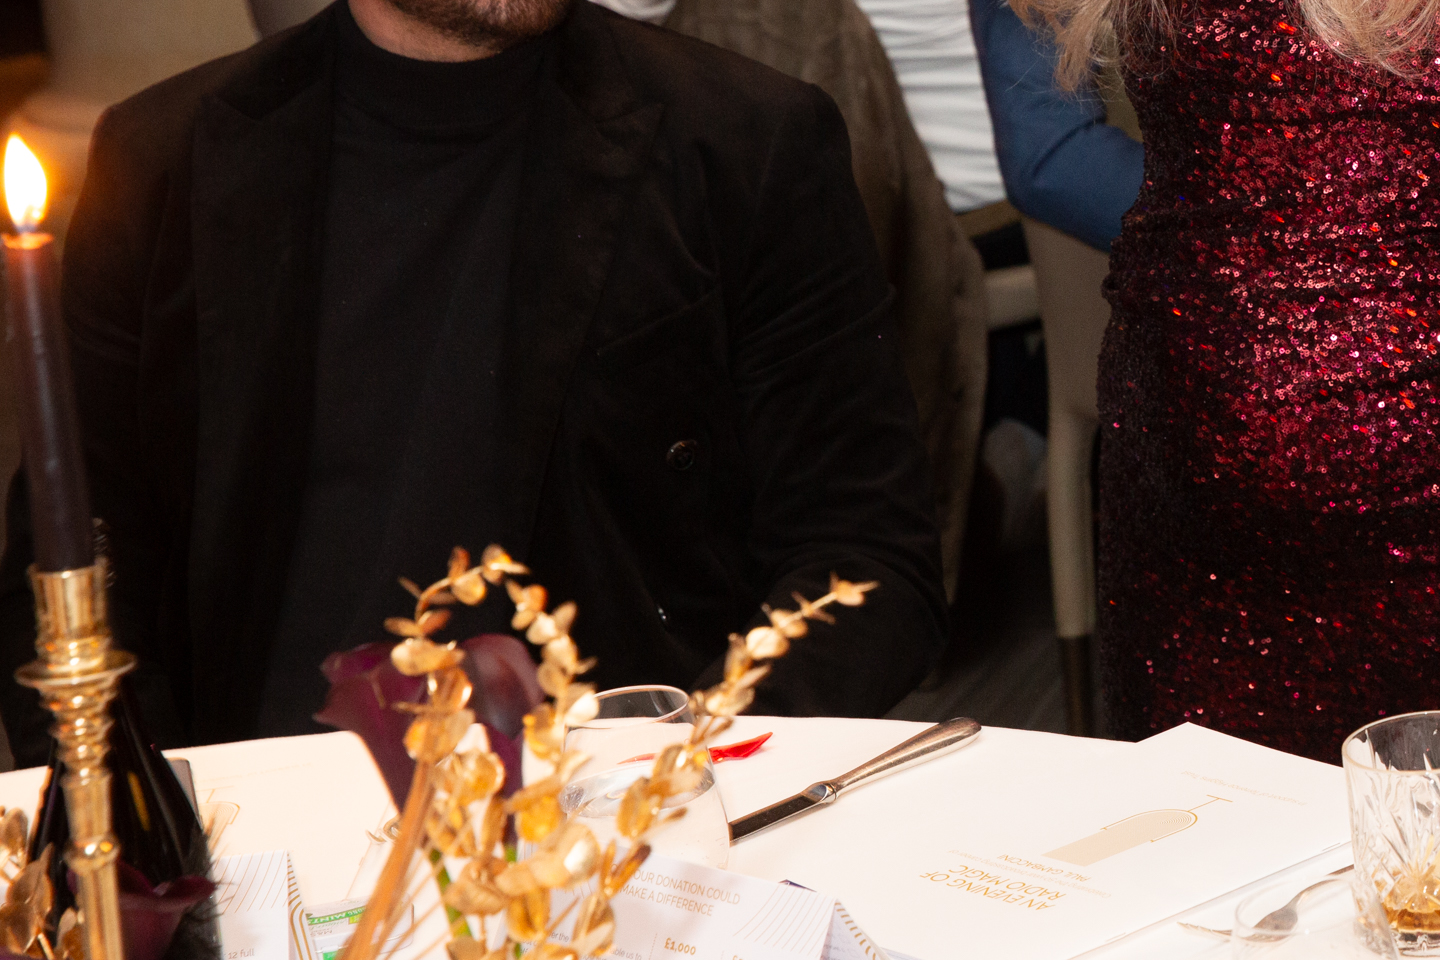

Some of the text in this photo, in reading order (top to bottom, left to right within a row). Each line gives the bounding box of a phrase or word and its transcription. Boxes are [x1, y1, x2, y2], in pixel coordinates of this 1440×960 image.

[948, 865, 1067, 901] RADIO MAGIC
[996, 854, 1092, 882] PAUL GAMBACCINI
[620, 883, 715, 917] MAKE A DIFFERENCE
[633, 870, 740, 905] OUR DONATION COULD
[919, 871, 1056, 910] AN EVENING OF
[228, 948, 255, 960] 12 full
[664, 937, 697, 956] £1,000
